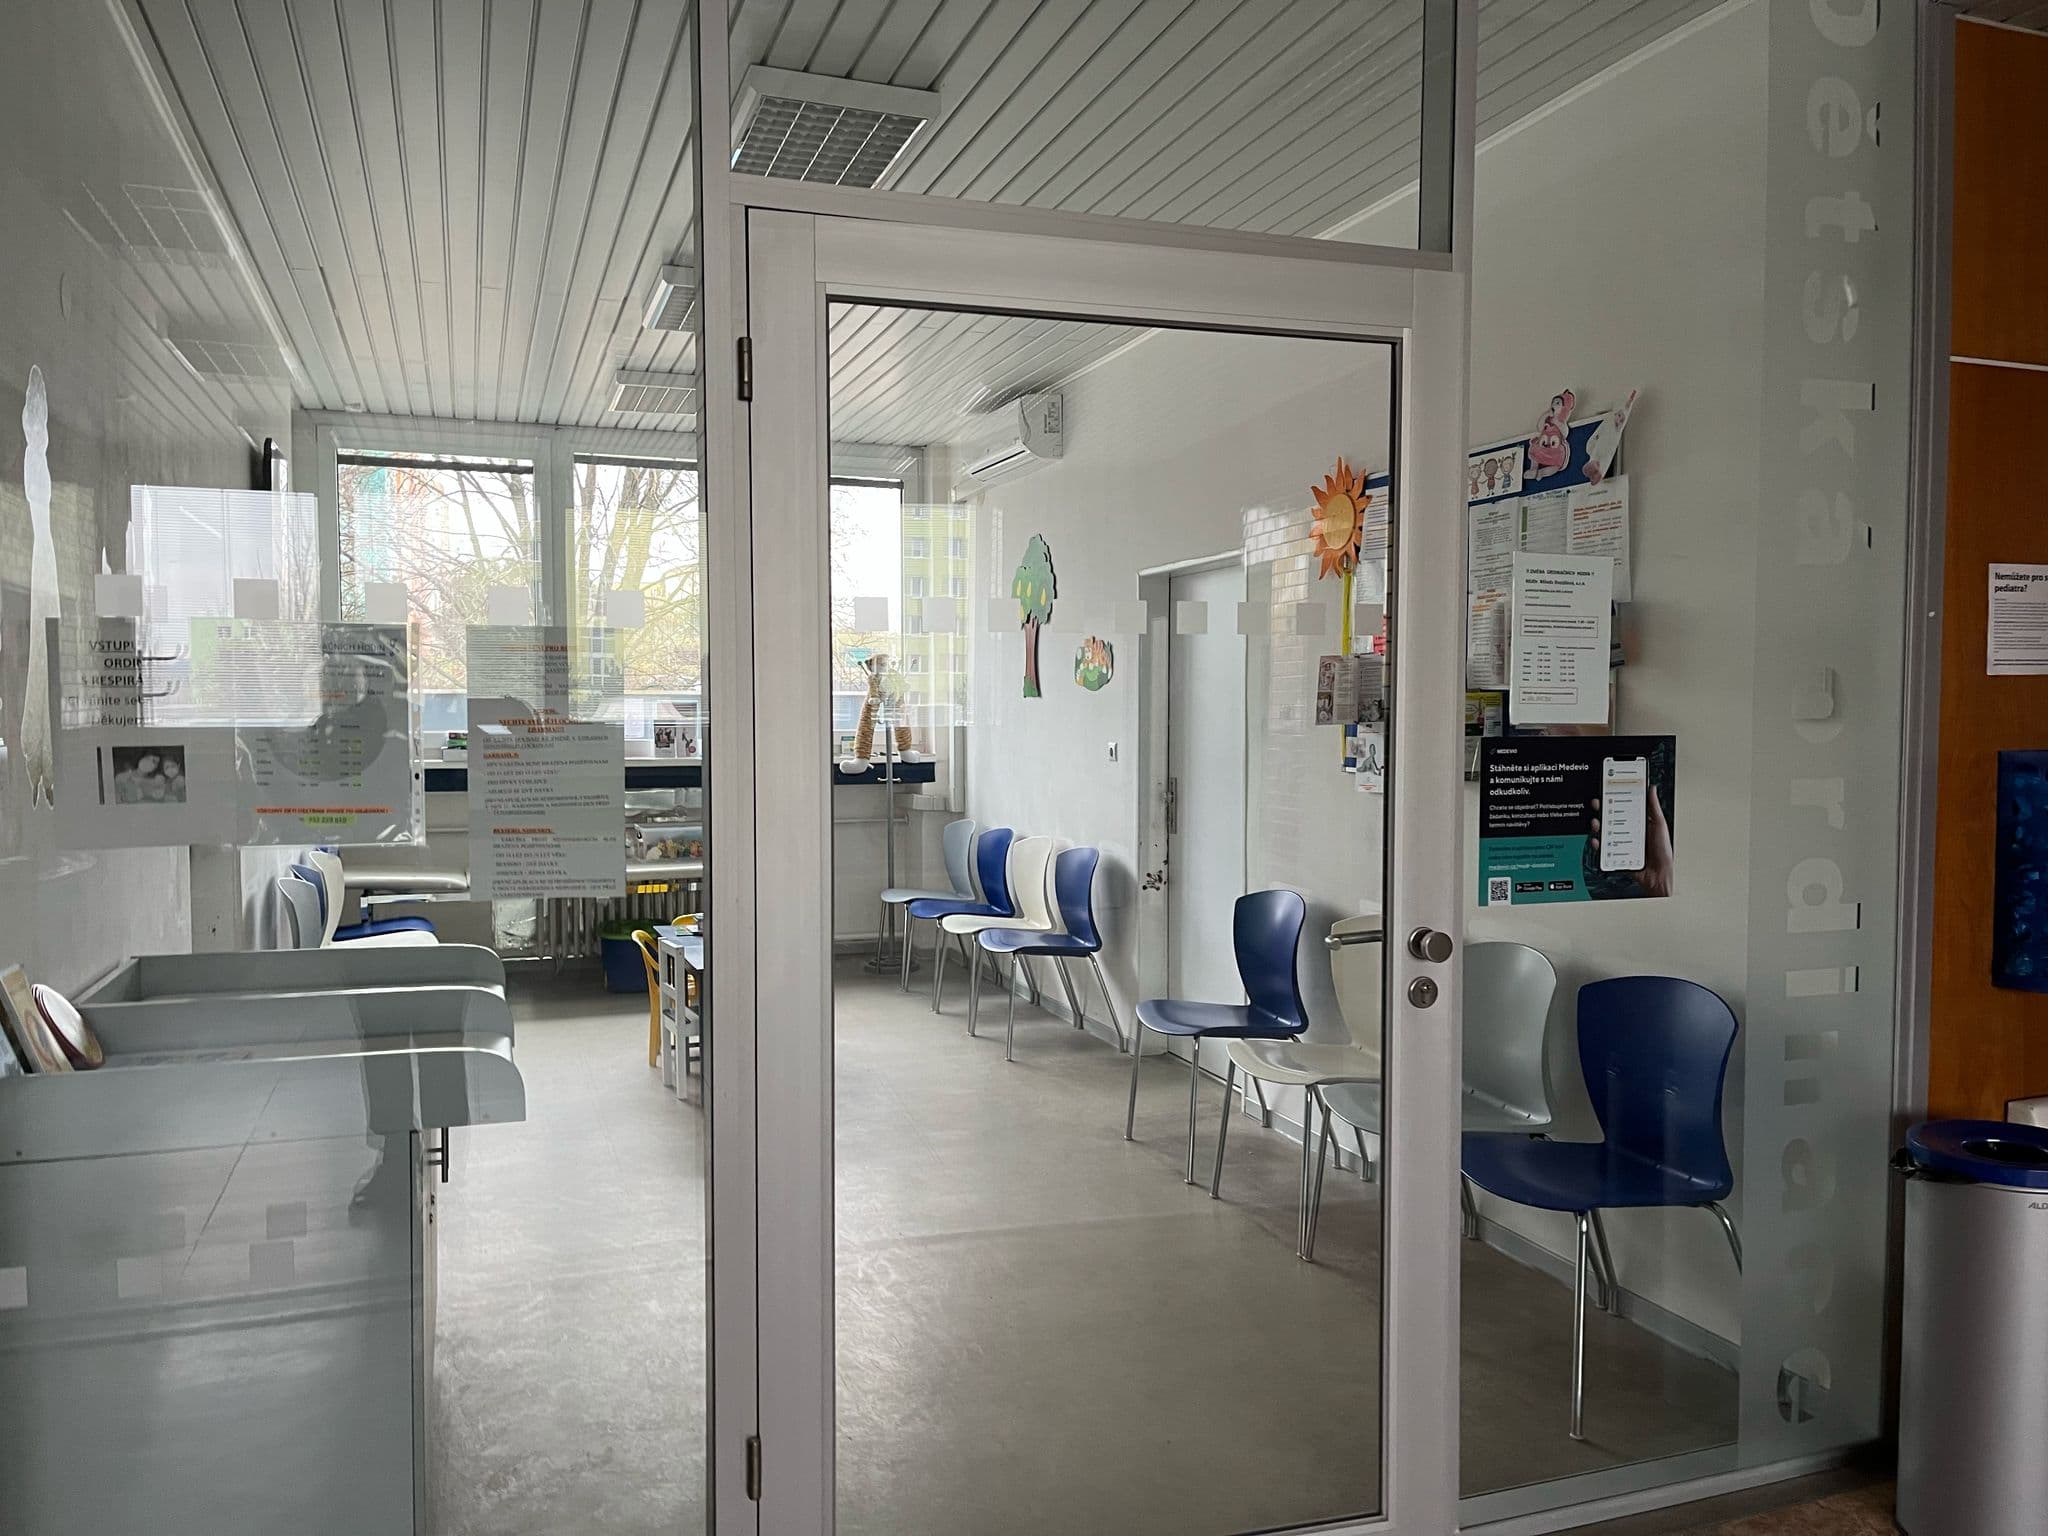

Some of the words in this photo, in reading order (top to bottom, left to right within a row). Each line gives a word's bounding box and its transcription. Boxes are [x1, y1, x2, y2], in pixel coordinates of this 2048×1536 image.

[1994, 572, 2031, 582] Nemůžete
[2031, 574, 2044, 583] pro
[1994, 584, 2028, 593] pediatra?
[1489, 764, 1523, 772] Stáhněte
[1523, 763, 1530, 771] si
[1530, 763, 1558, 774] aplikaci
[1558, 763, 1590, 771] Medevio
[1495, 776, 1540, 785] komunikujte
[1545, 775, 1564, 783] námi
[1489, 787, 1532, 796] odkudkoliv.
